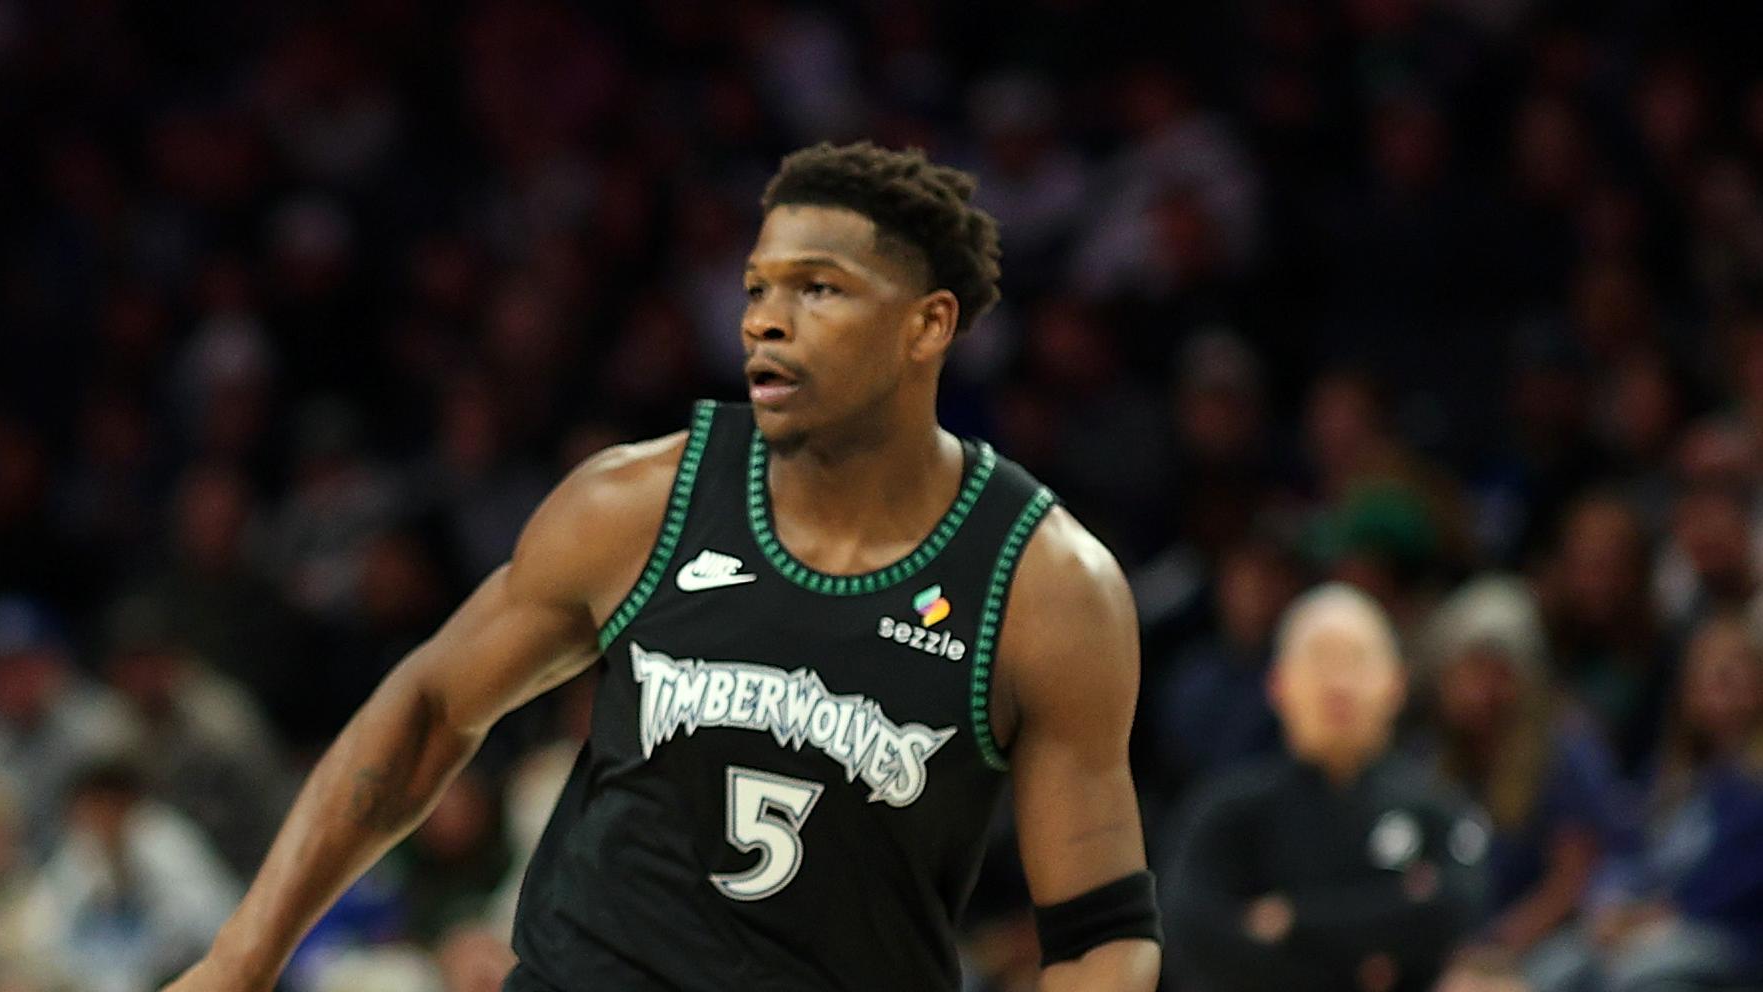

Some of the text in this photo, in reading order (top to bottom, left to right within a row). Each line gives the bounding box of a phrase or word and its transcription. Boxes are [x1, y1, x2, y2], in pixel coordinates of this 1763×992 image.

[877, 616, 967, 661] sezzle
[629, 641, 959, 808] TIMBERWOLVES
[709, 766, 826, 901] 5
